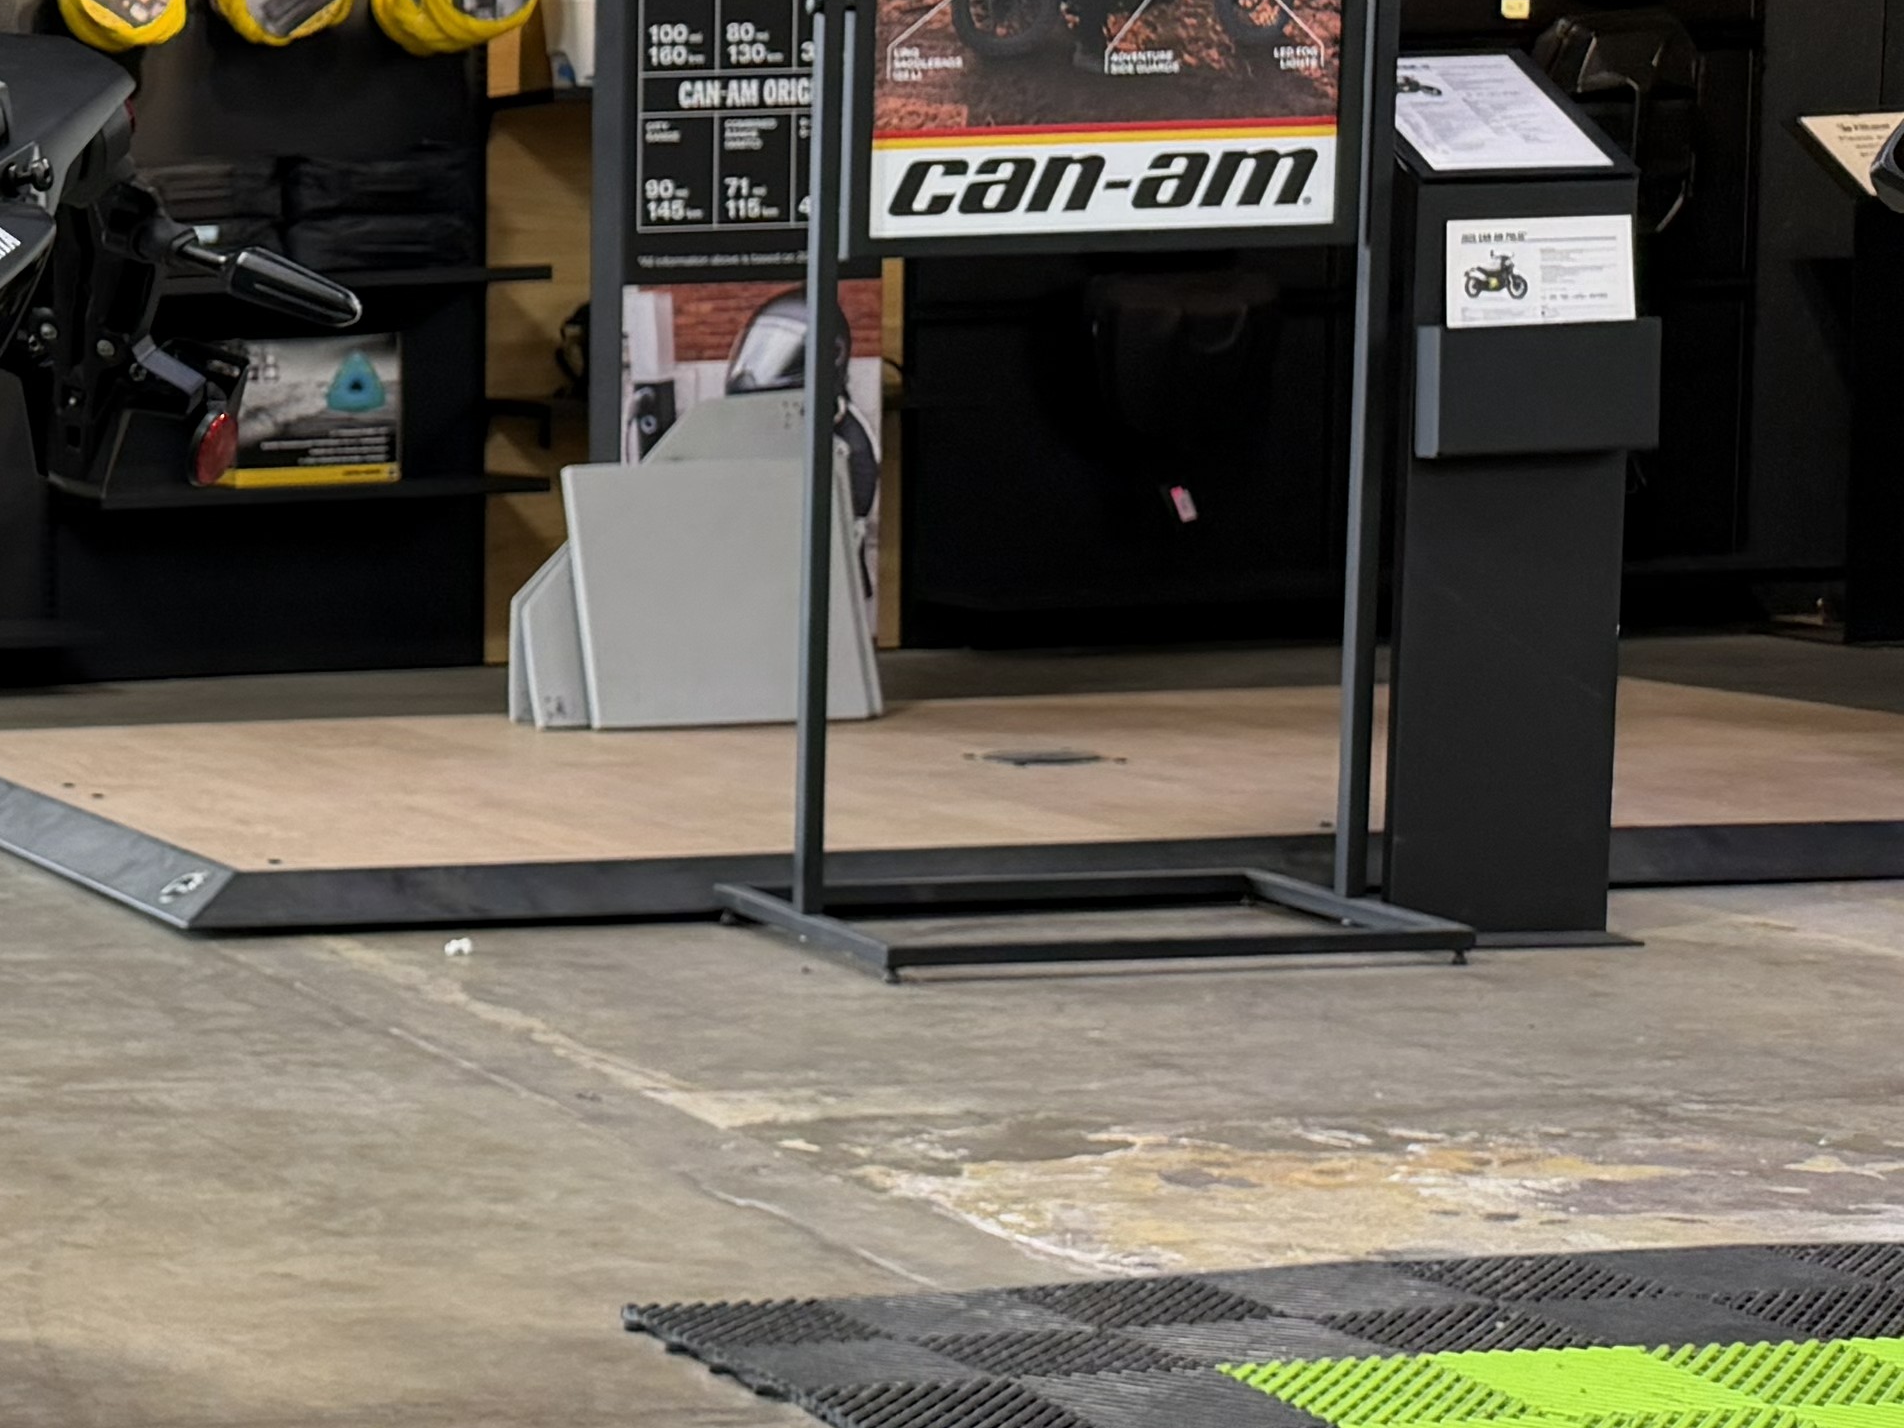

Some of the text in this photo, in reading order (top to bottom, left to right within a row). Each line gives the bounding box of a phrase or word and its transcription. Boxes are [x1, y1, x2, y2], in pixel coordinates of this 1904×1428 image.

[648, 23, 689, 45] 100
[727, 43, 767, 64] 130
[678, 77, 812, 109] CAN-AM ORIG
[724, 177, 749, 197] 71
[888, 147, 1319, 217] can-am
[647, 199, 686, 221] 145
